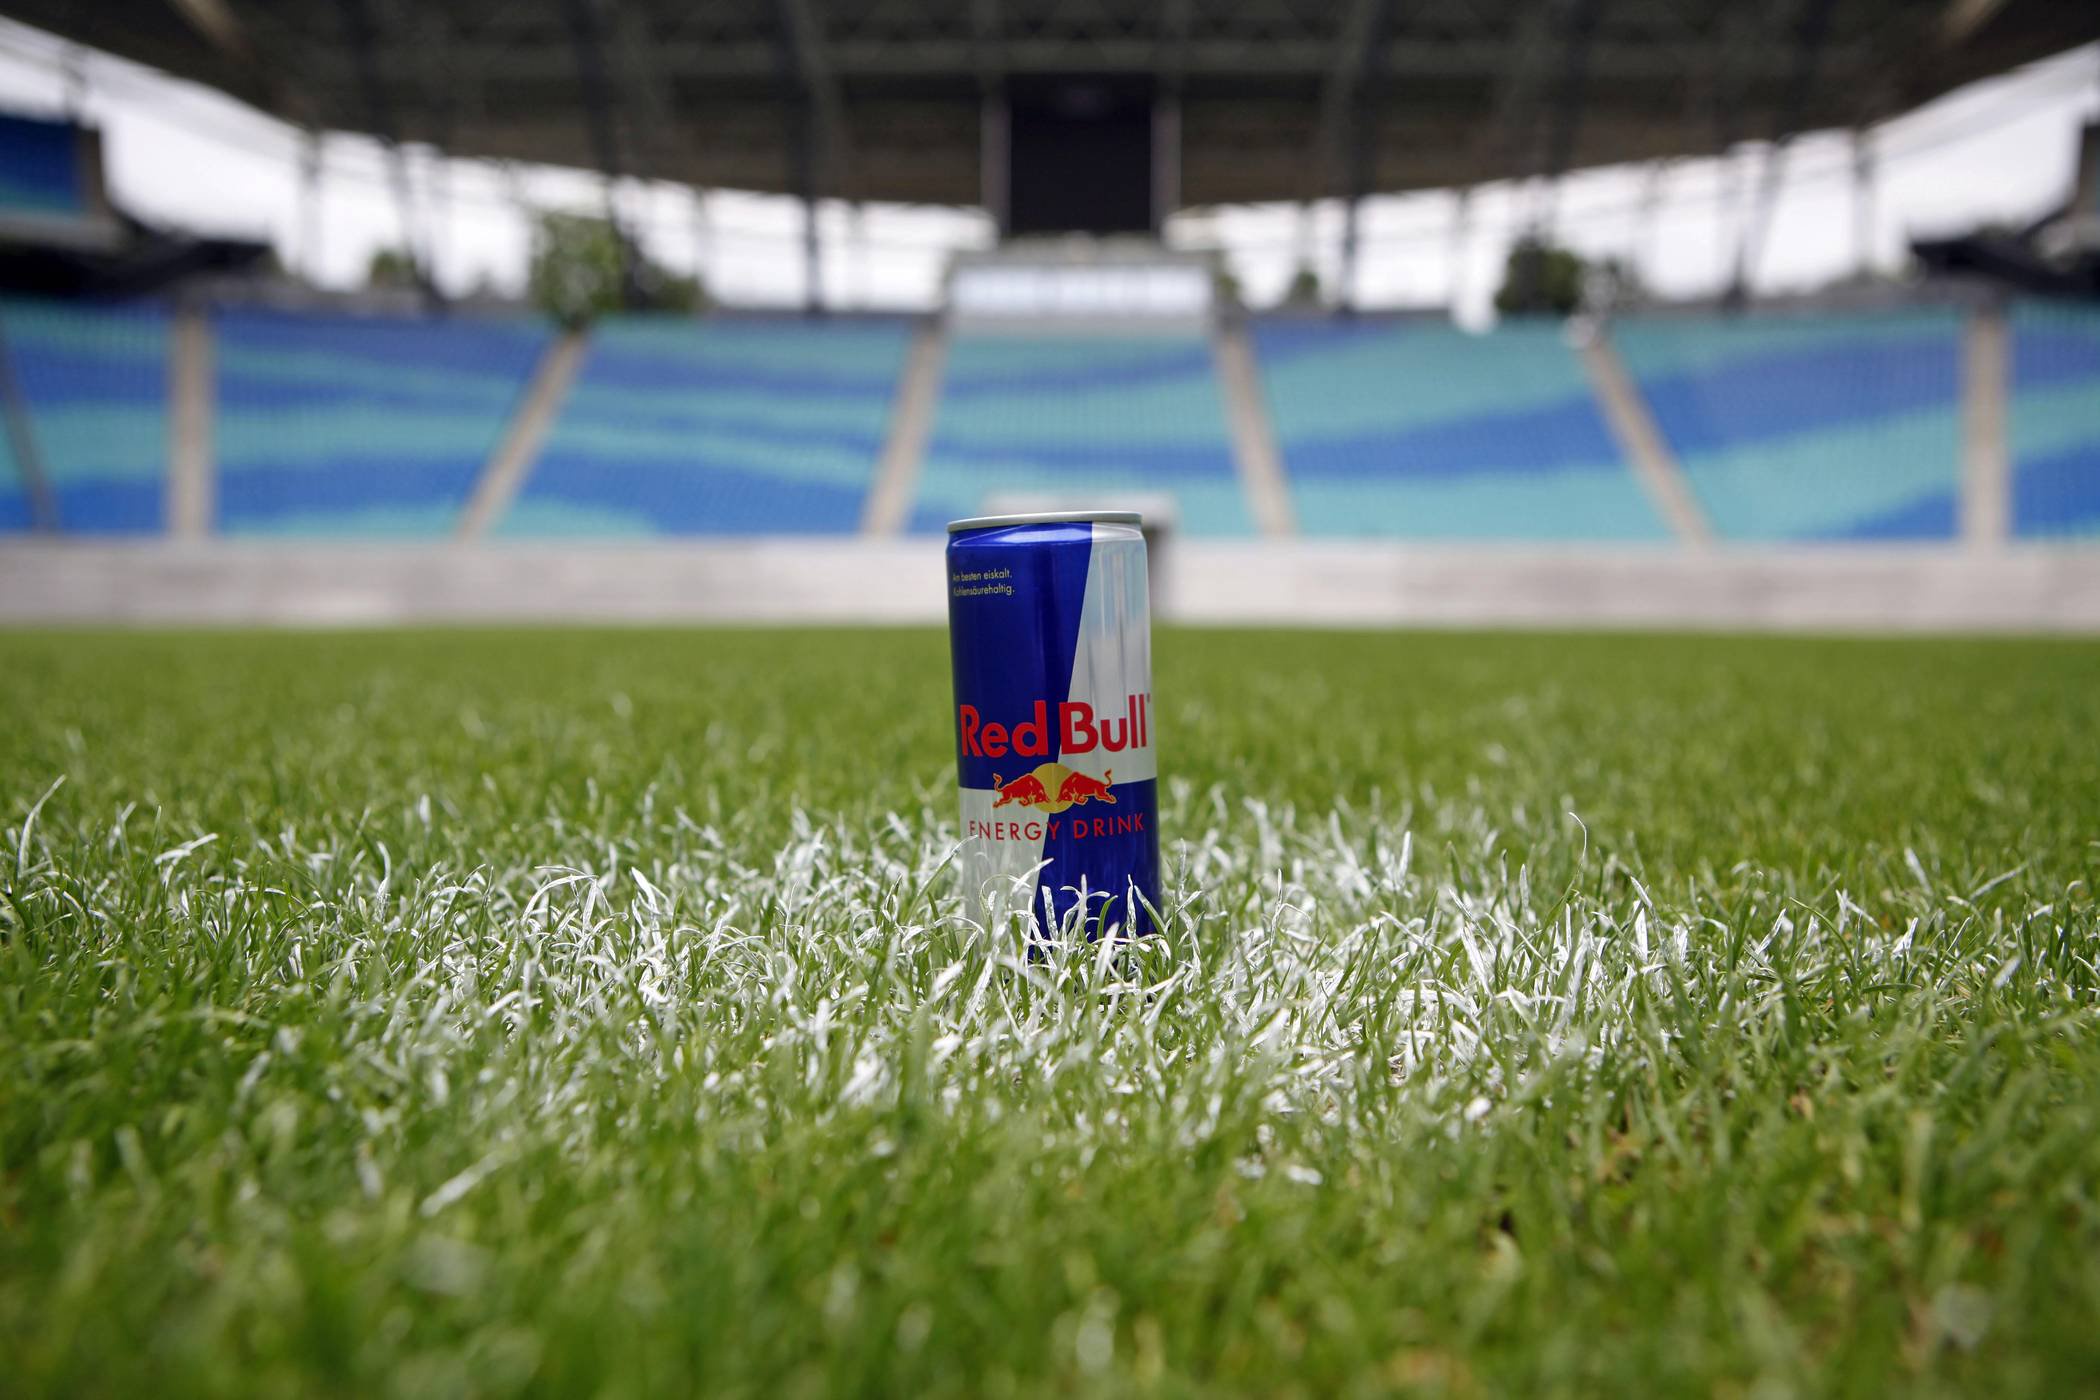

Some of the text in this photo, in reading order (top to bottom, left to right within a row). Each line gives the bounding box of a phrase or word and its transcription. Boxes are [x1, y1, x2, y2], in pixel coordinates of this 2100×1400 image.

[961, 570, 982, 582] besten
[983, 567, 1013, 580] eiskalt.
[960, 693, 1147, 758] Red Bull
[968, 812, 1145, 841] ENERGY DRINK
